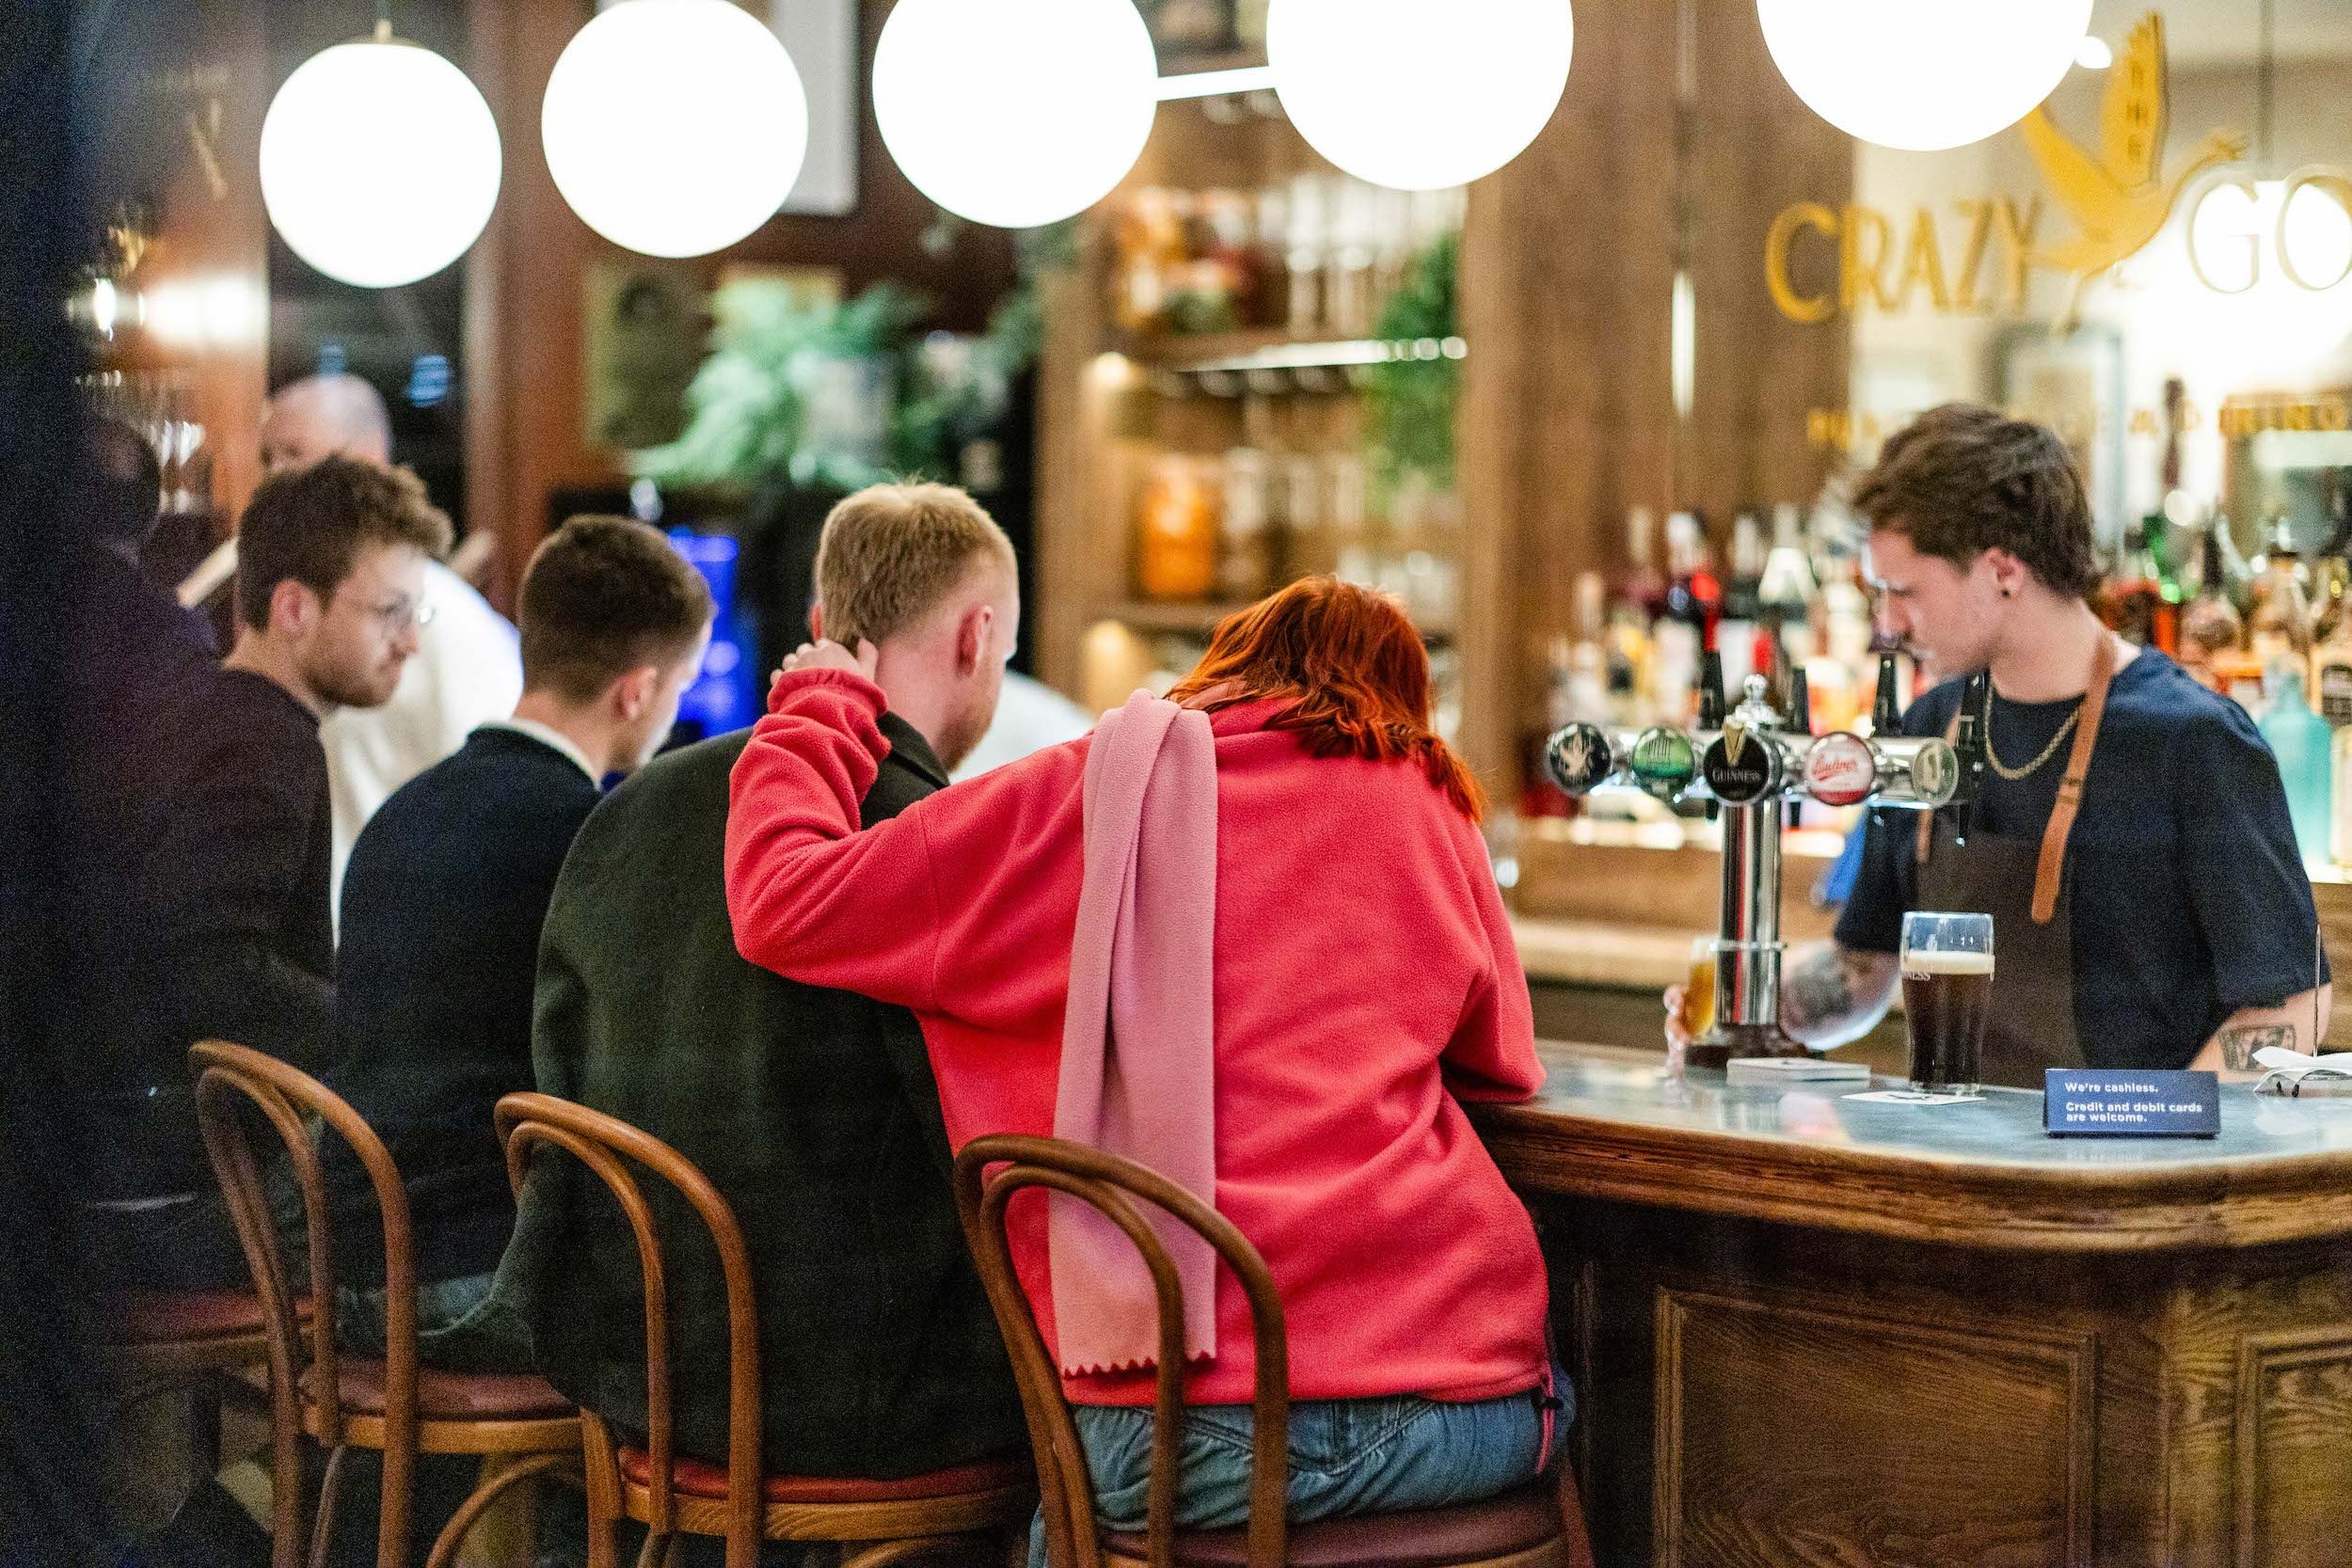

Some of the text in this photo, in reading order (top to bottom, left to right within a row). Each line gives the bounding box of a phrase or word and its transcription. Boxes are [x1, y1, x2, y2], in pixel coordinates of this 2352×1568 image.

[1764, 195, 2044, 323] CRAZY
[1711, 767, 1762, 784] GUINNESS
[2064, 1083, 2159, 1093] We're cashless.
[2065, 1101, 2202, 1113] Credit and debit cards
[2066, 1112, 2148, 1122] are welcome.
